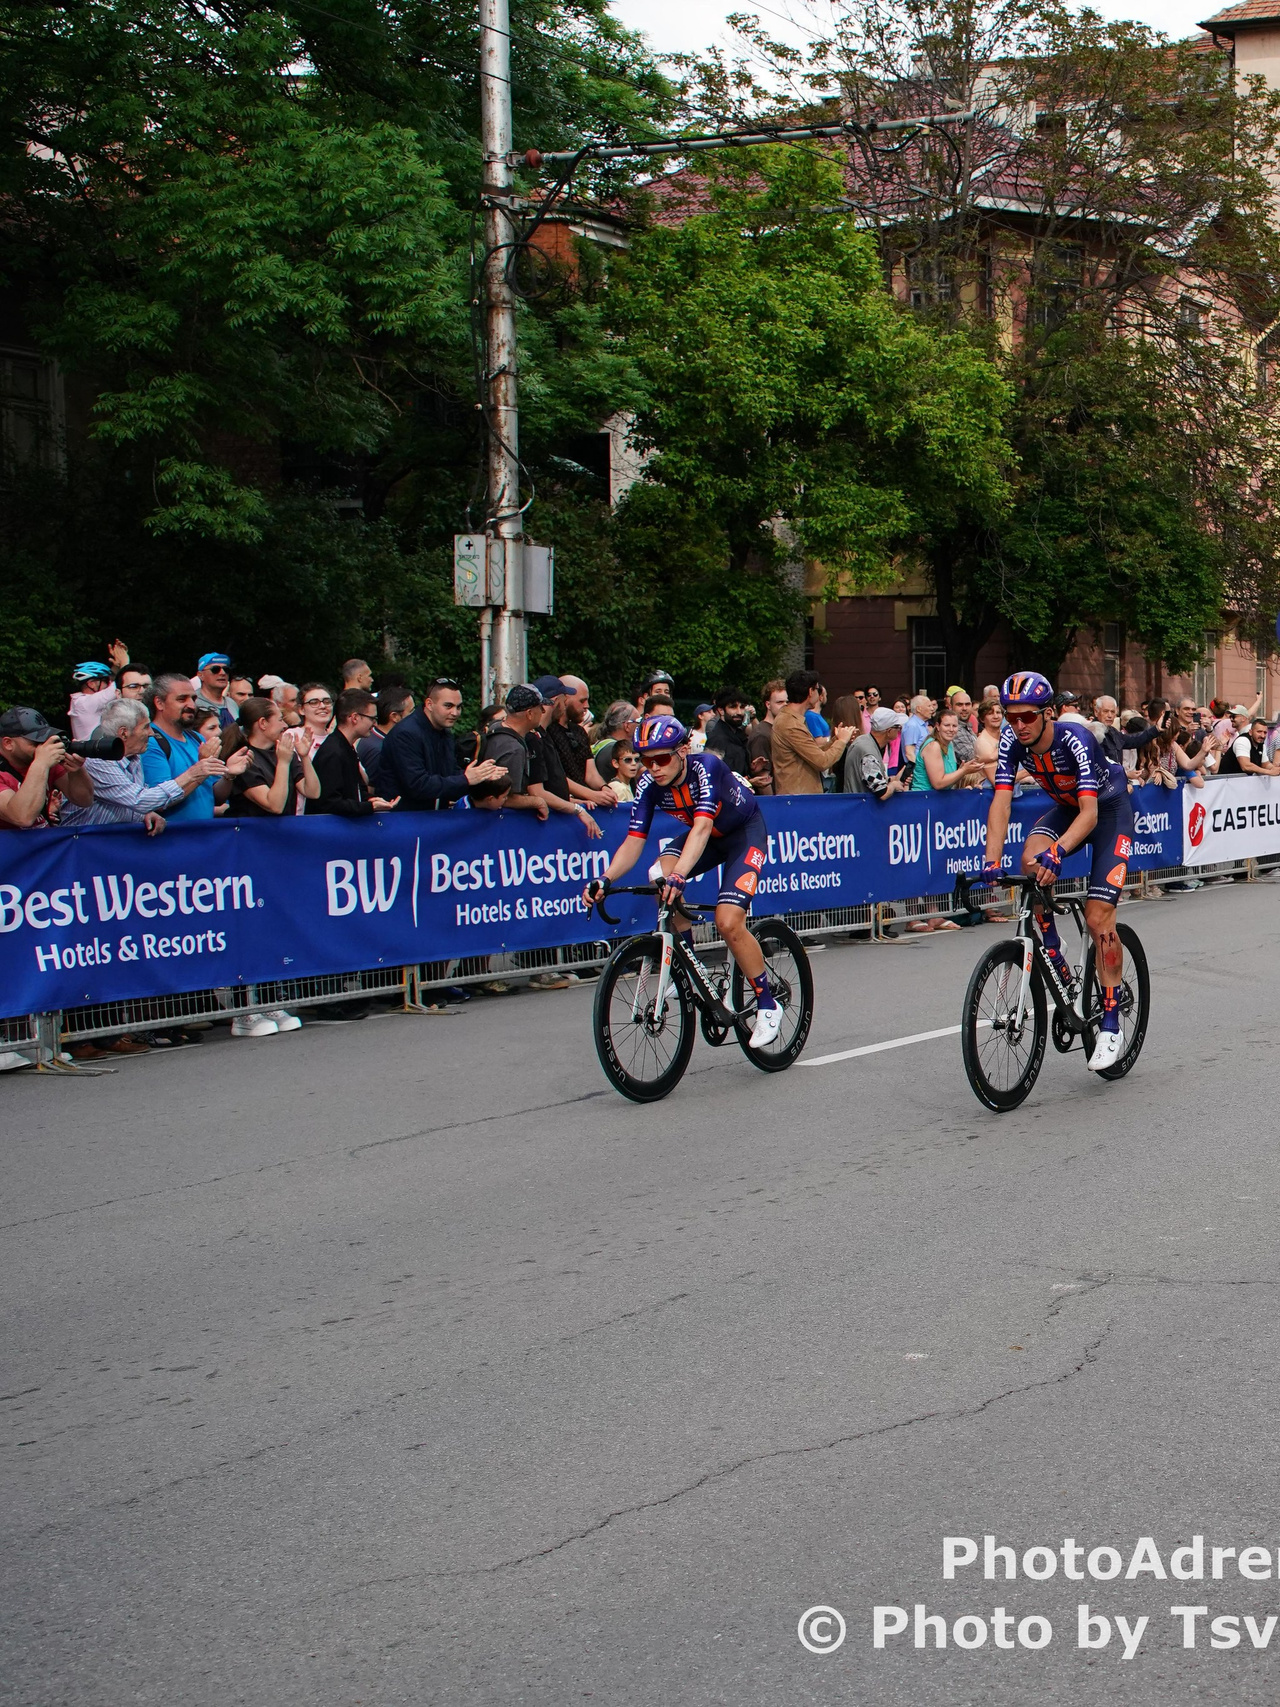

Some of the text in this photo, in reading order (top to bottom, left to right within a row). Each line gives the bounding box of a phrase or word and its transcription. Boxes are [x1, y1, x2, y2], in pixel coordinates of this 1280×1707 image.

[999, 724, 1018, 758] raisi
[1068, 734, 1091, 776] raisin
[888, 818, 1022, 865] BW Best Wern
[326, 856, 401, 916] BW
[430, 854, 496, 894] Best
[755, 870, 842, 894] otels & Resorts
[946, 856, 972, 874] Hotels
[974, 855, 980, 871] &
[0, 881, 89, 934] Best
[456, 894, 588, 926] Hotels & Resorts
[35, 930, 226, 972] Hotels & Resorts
